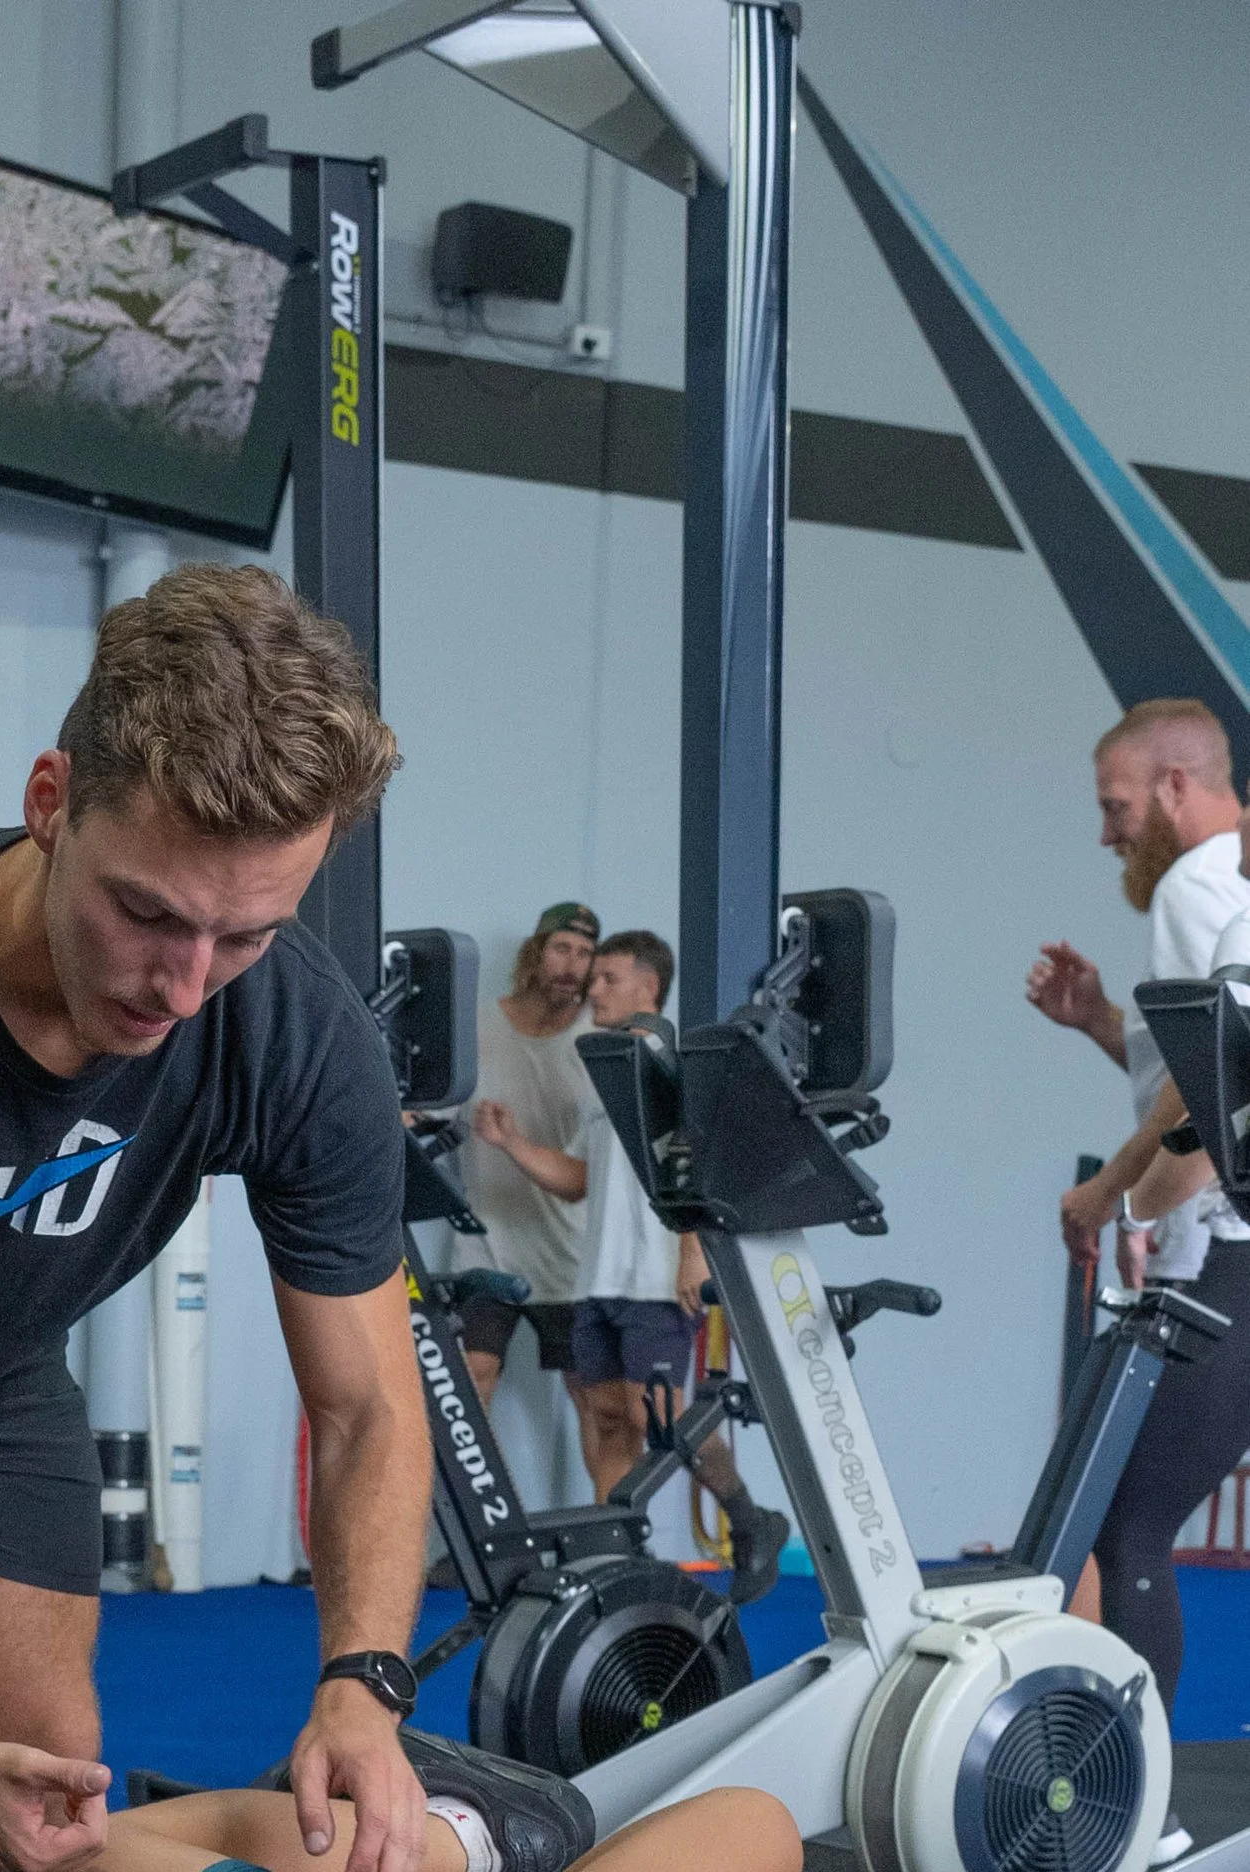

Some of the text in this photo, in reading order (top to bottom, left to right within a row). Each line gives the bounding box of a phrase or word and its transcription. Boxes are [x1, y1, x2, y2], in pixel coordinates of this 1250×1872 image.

[410, 1312, 510, 1527] concept 2
[797, 1328, 897, 1578] concept 2
